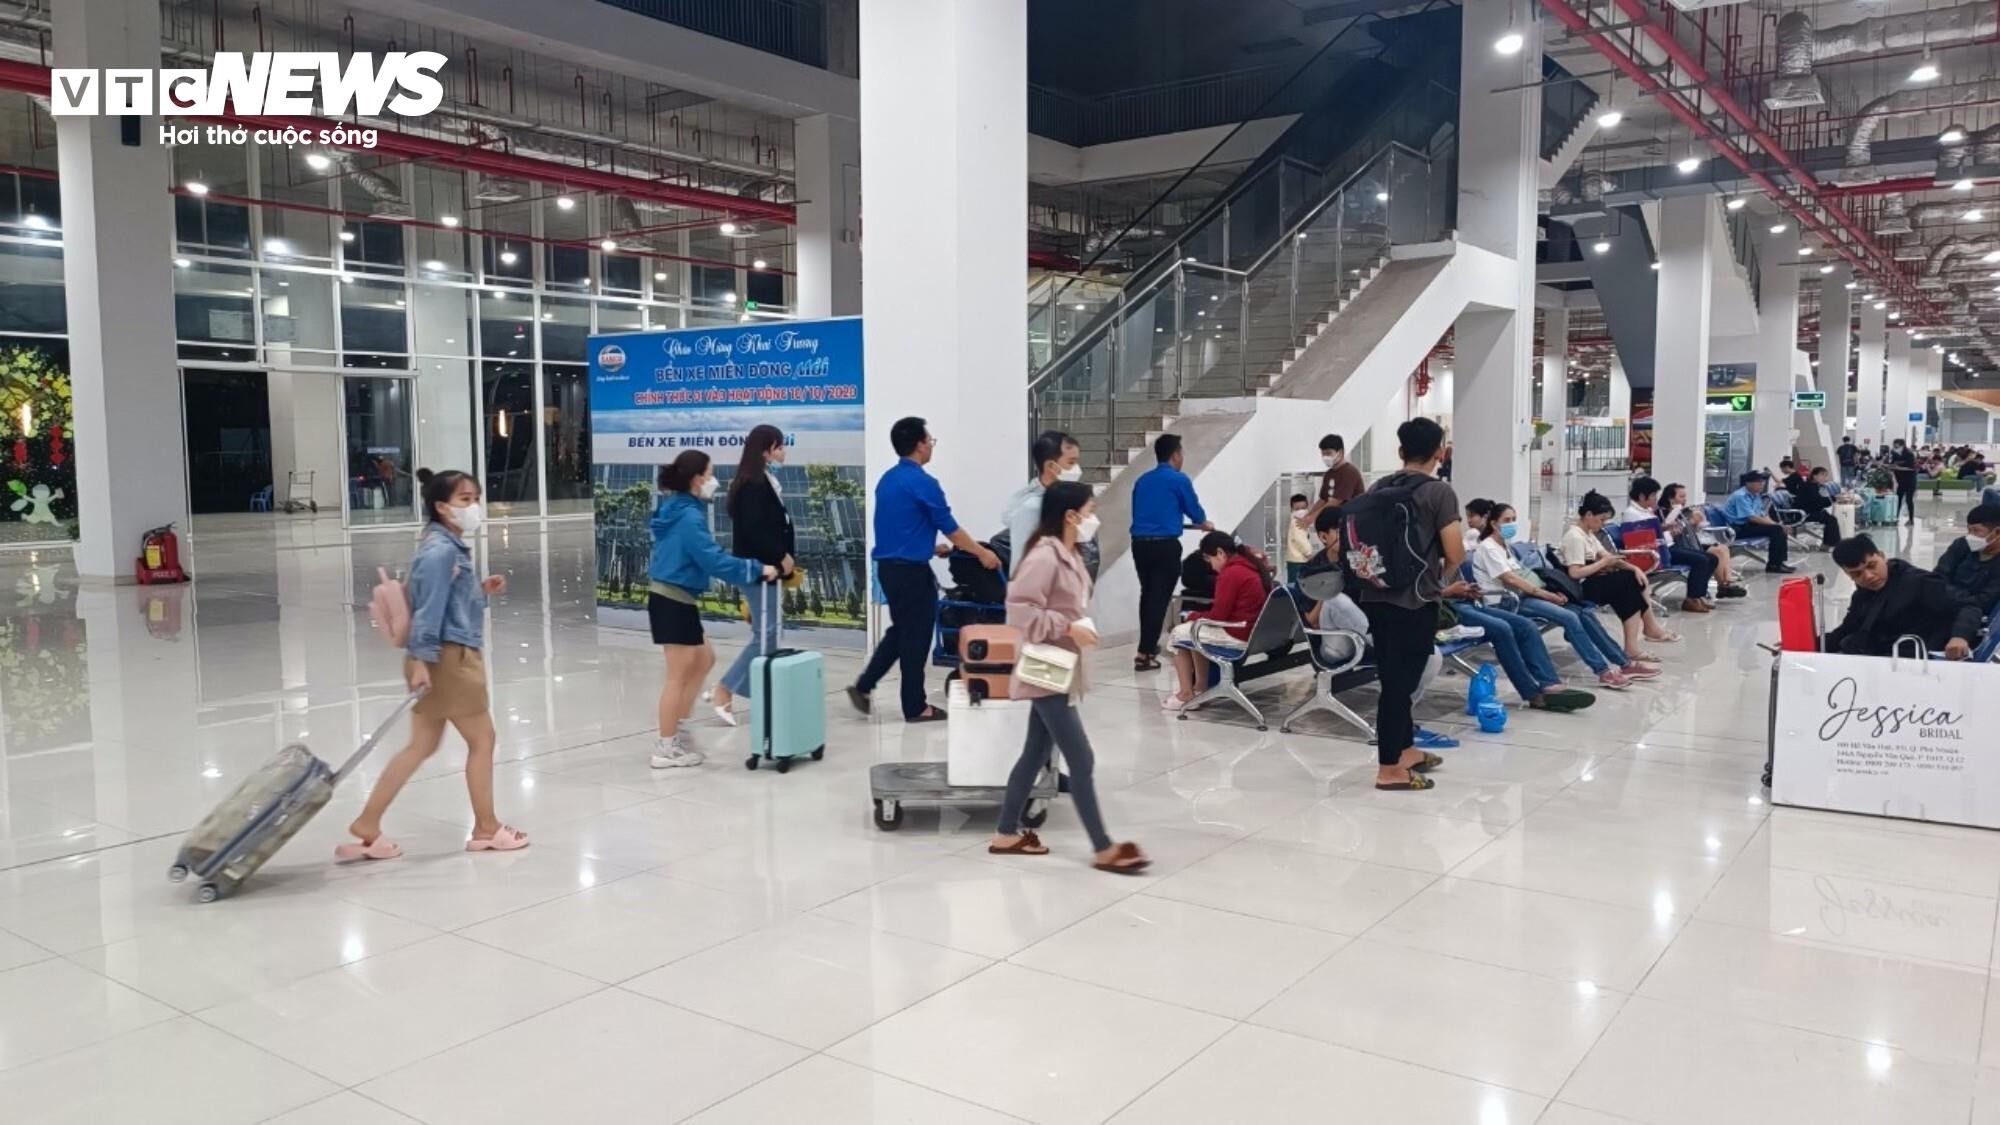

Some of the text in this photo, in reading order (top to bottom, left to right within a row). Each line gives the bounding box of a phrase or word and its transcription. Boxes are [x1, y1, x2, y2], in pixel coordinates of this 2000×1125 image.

[687, 364, 705, 381] XE
[658, 436, 676, 447] XE
[718, 434, 749, 447] ĐÔN
[1818, 677, 1964, 741] Jessica
[1919, 727, 1964, 740] BRIDAL
